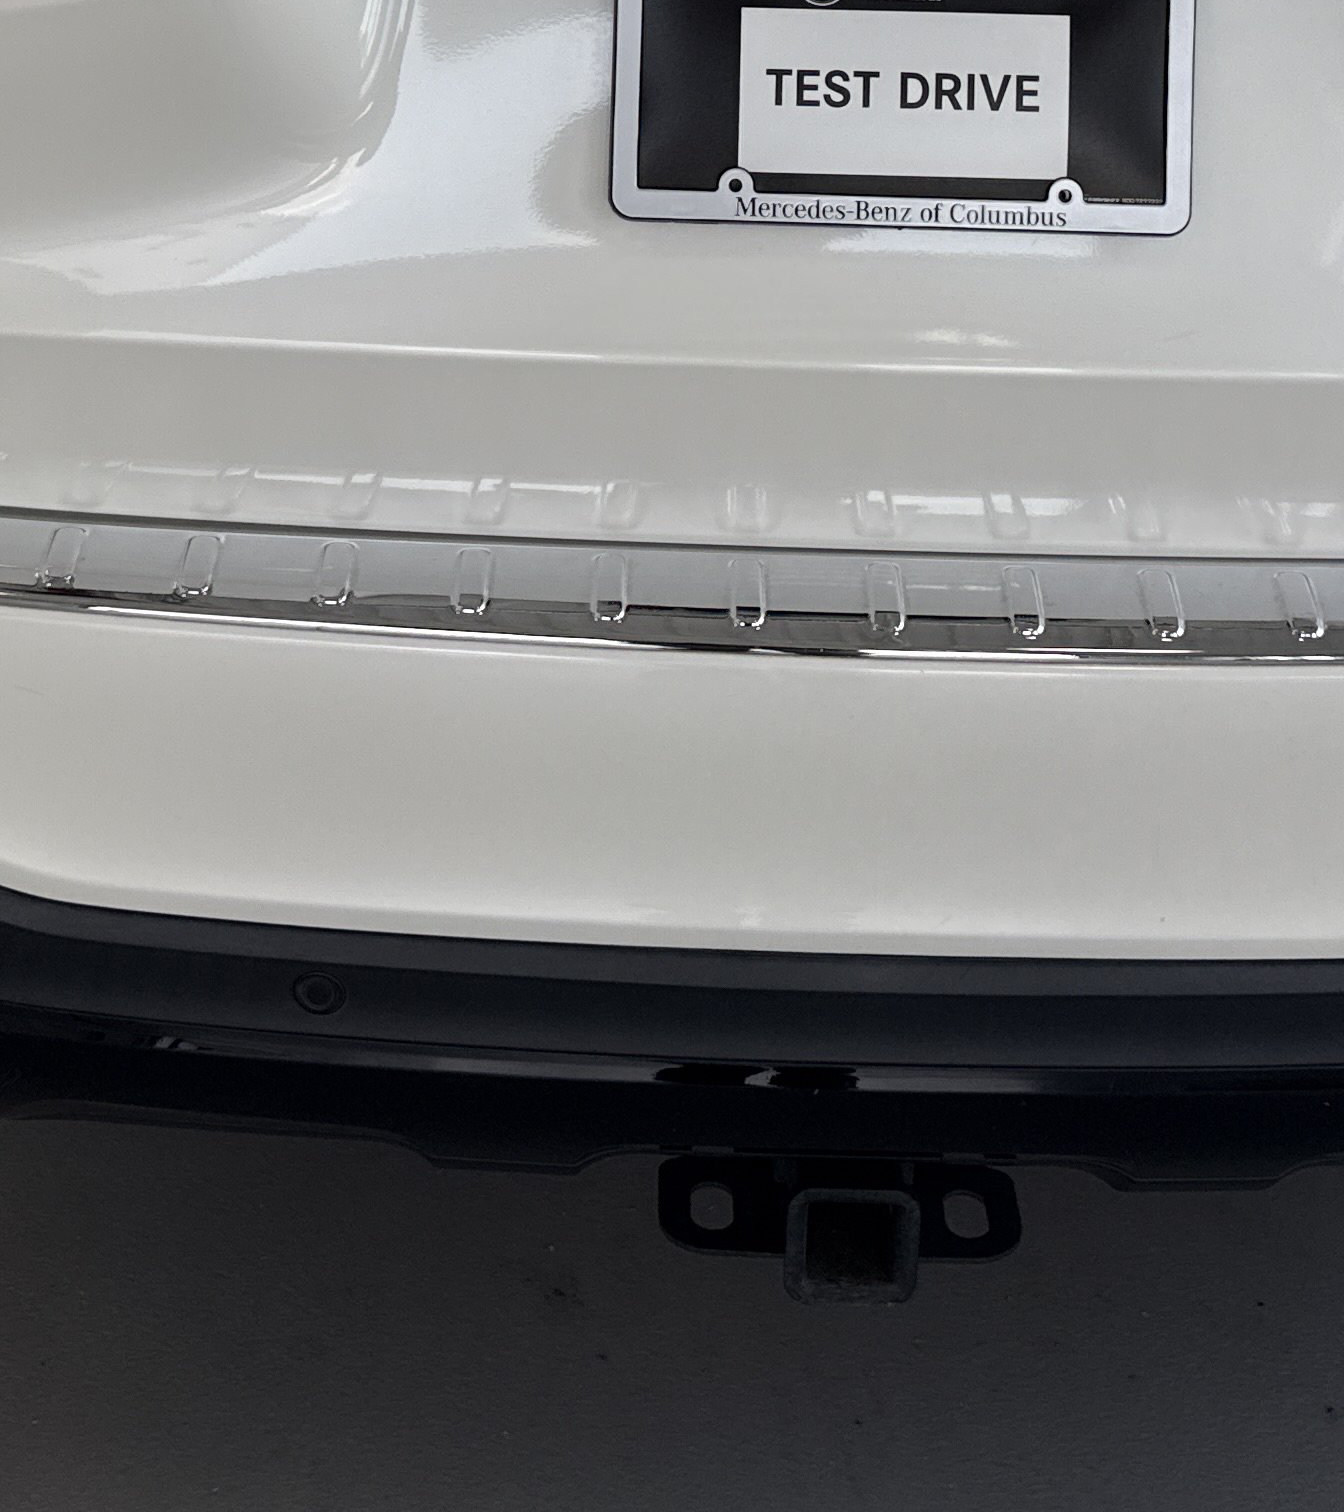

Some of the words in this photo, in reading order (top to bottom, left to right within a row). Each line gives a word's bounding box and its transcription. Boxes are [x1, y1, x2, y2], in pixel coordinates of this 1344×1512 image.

[765, 68, 880, 109] TEST
[899, 72, 1041, 113] DRIVE
[734, 195, 912, 224] Mercedes-Benz
[919, 203, 942, 225] of
[948, 202, 1068, 228] Columbus
